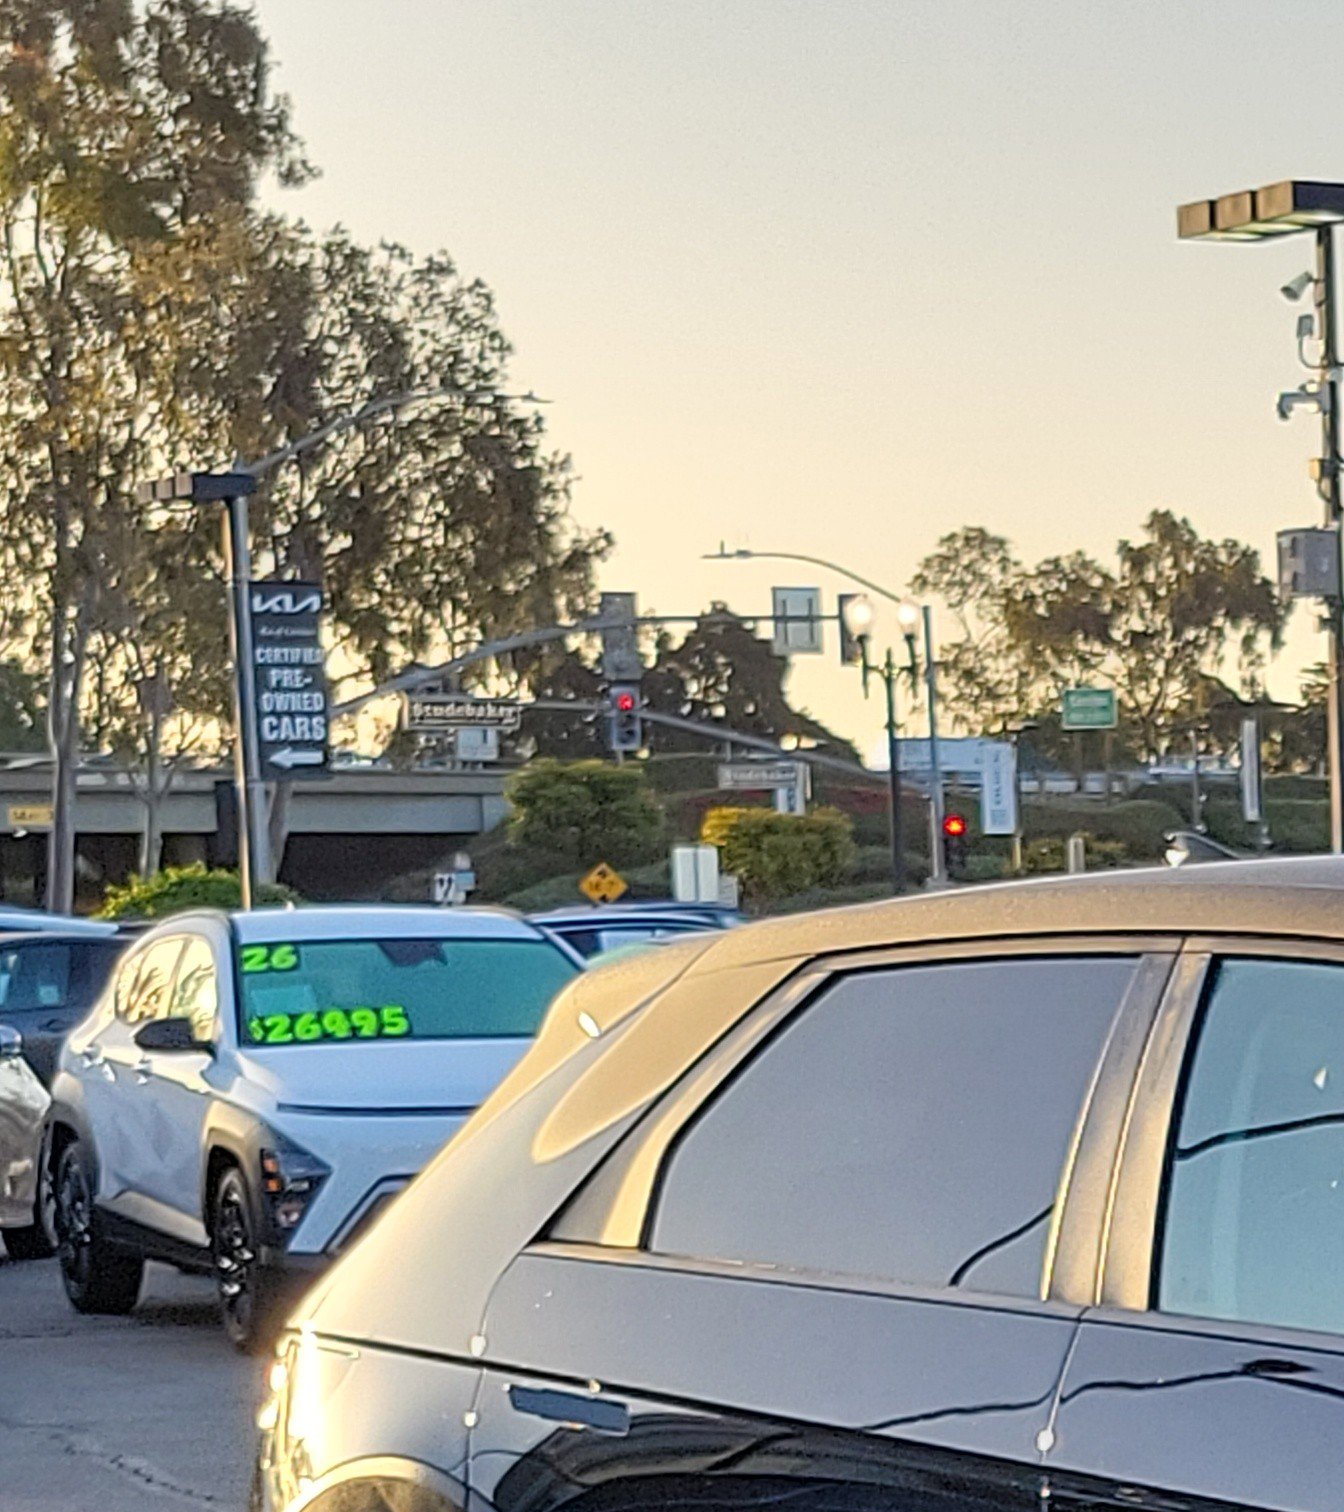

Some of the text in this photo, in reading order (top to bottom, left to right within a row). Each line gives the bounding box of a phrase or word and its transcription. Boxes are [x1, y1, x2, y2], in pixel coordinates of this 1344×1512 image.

[252, 591, 321, 613] KIA
[269, 668, 313, 688] PRE-
[261, 692, 324, 712] OWNED
[261, 715, 325, 742] CARS
[241, 944, 298, 972] 26
[249, 1004, 410, 1042] $26995
